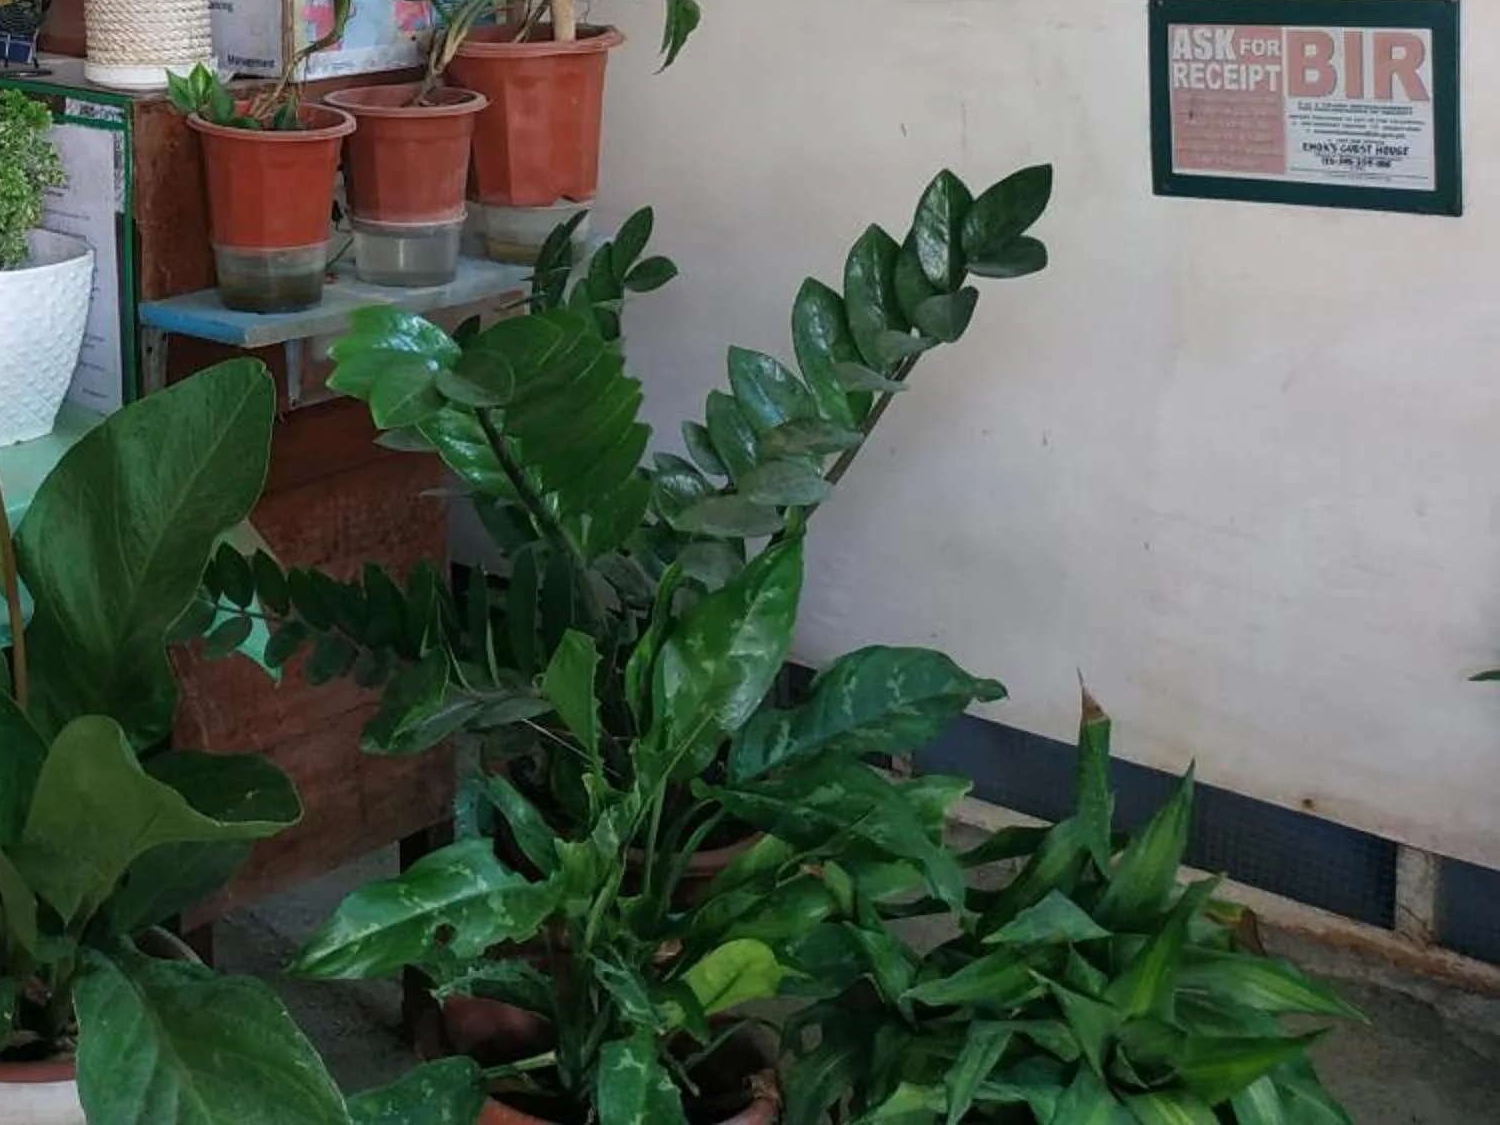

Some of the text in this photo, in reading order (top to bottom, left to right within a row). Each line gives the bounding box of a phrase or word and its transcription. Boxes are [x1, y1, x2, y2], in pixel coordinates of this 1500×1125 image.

[1173, 27, 1430, 102] ASK FOR BIR
[1173, 62, 1281, 92] RECEIPT
